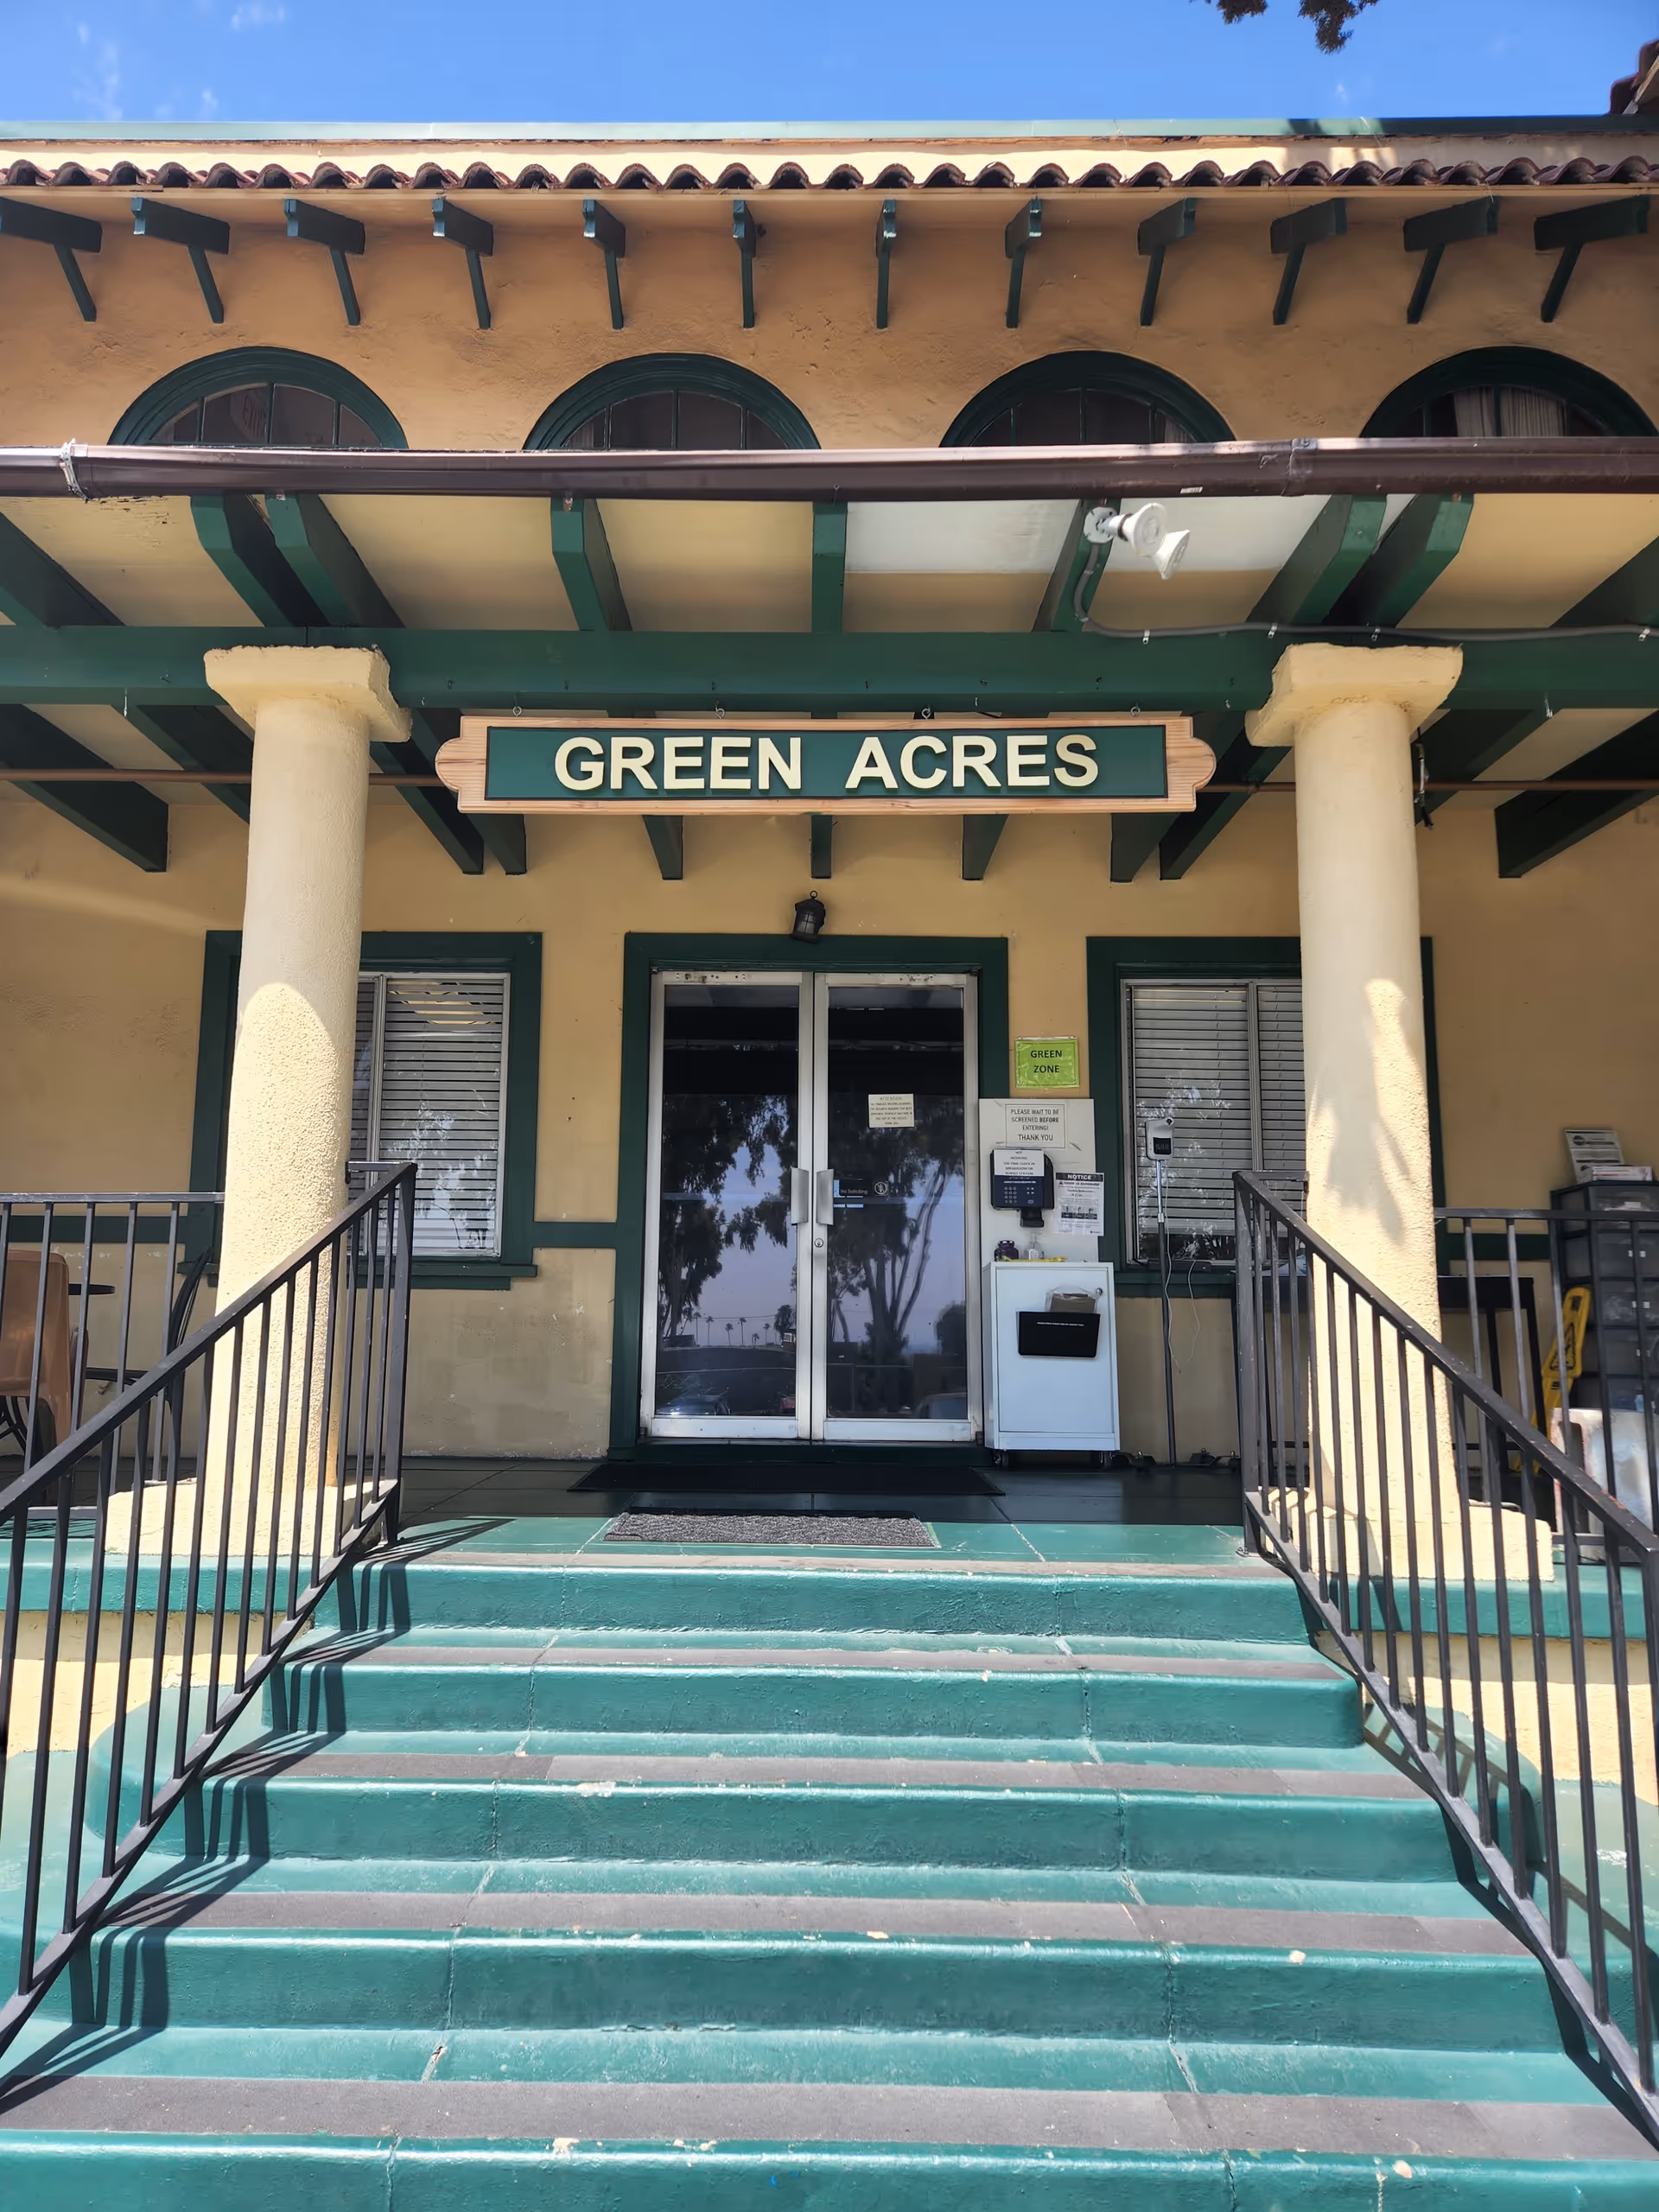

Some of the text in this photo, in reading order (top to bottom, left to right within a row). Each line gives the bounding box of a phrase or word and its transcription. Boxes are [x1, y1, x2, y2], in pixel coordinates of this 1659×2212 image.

[554, 734, 1099, 791] GREEN ACRES
[1033, 1065, 1059, 1073] ZONE
